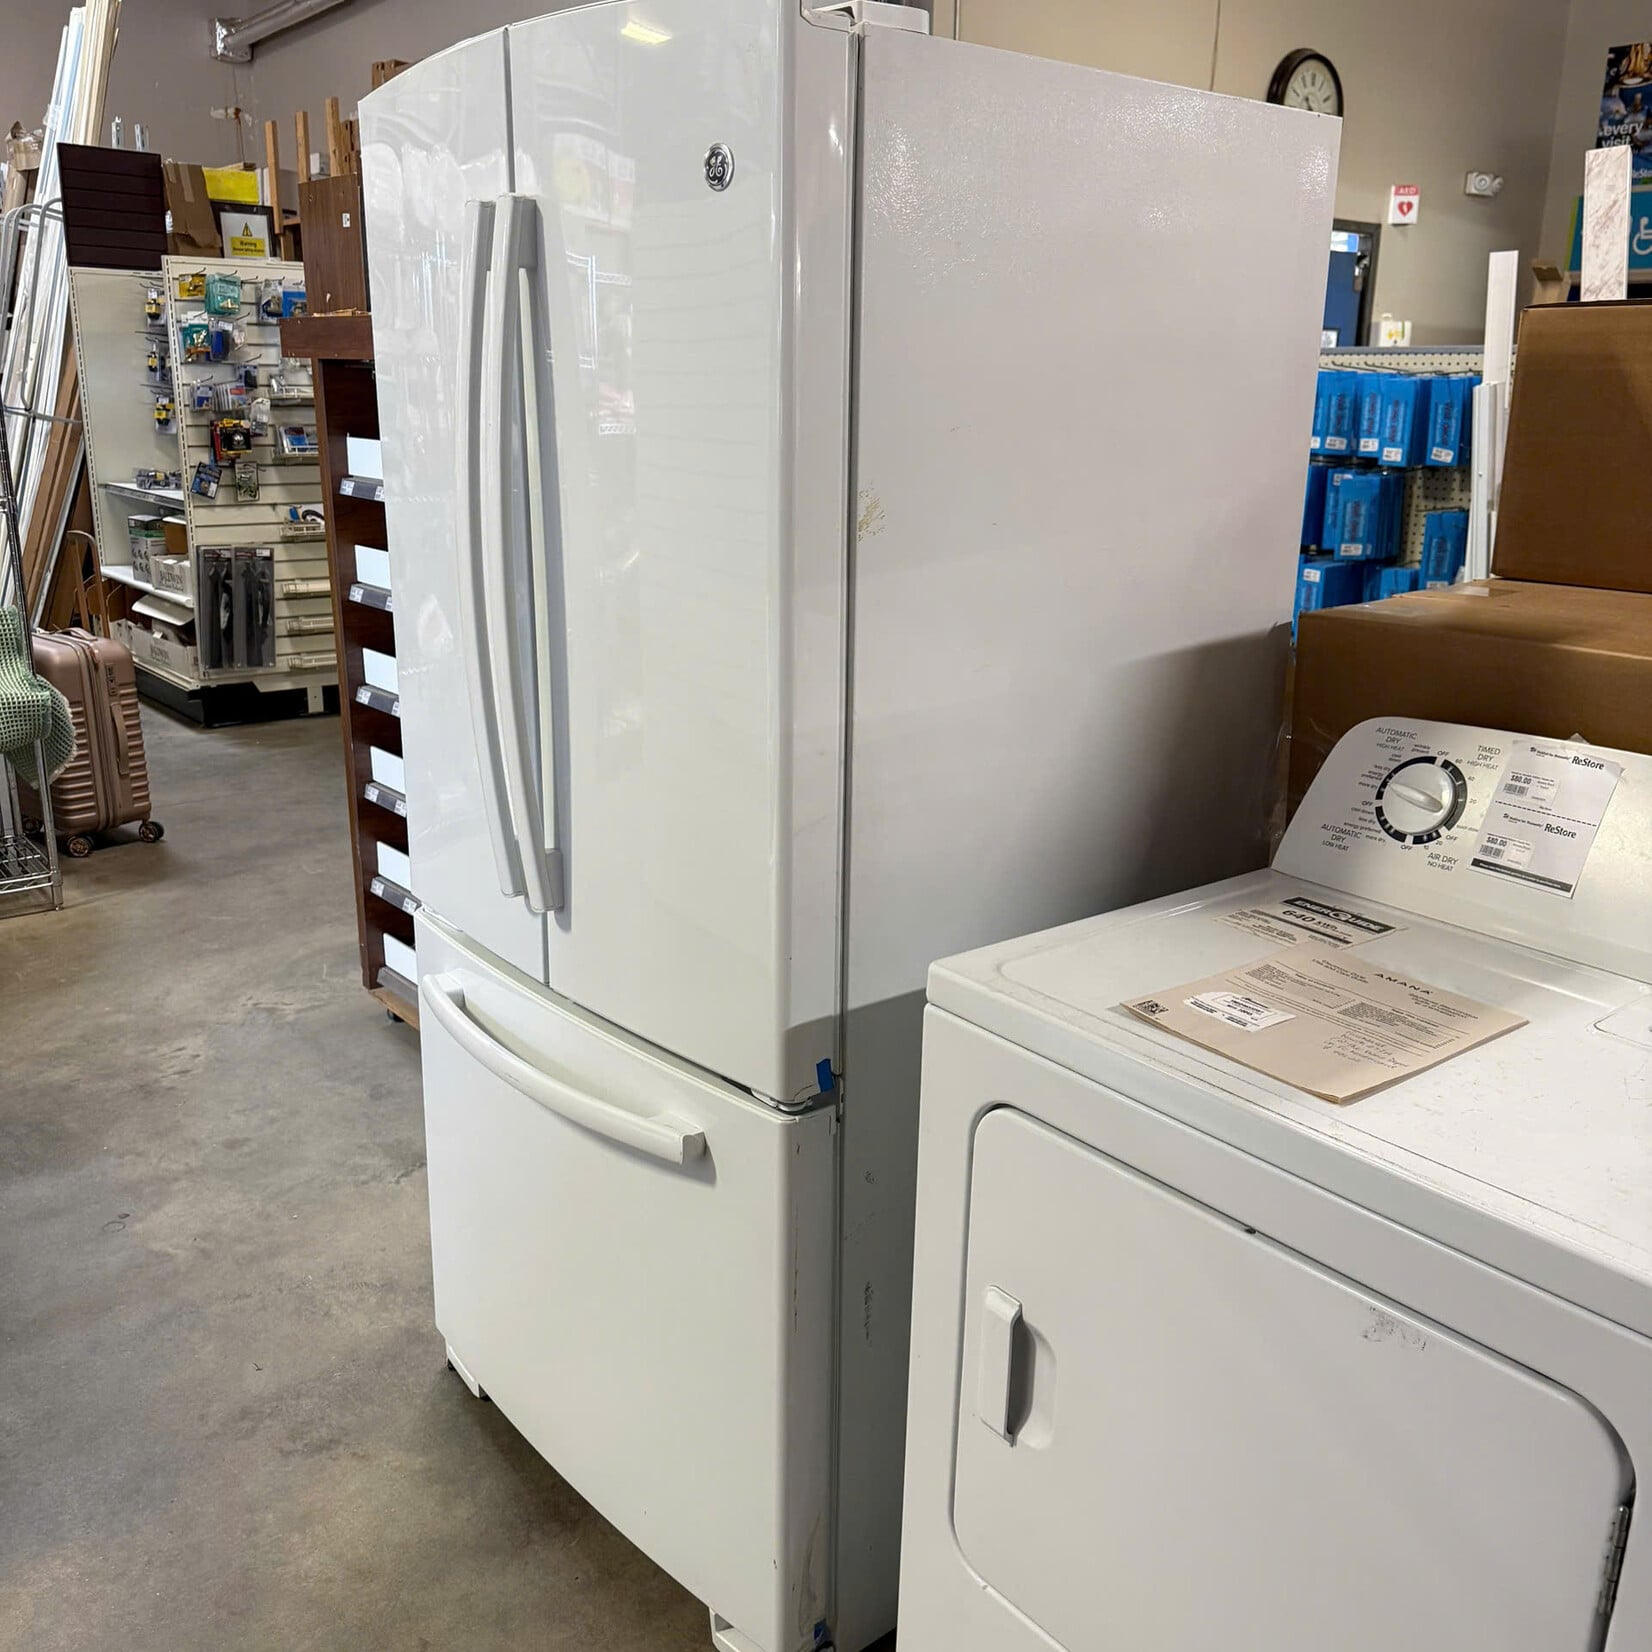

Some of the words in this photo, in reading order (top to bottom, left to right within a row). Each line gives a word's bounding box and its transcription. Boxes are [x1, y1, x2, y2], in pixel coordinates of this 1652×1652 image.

[1376, 728, 1418, 740] AUTOMATIC
[1478, 746, 1501, 755] TIMED
[1477, 754, 1494, 762] DRY
[1572, 756, 1604, 770] ReStore
[1510, 774, 1532, 785] $80.00
[1320, 823, 1362, 839] AUTOMATIC
[1544, 823, 1576, 838] ReStore
[1331, 834, 1346, 843] DRY
[1335, 843, 1349, 851] HEAT
[1428, 852, 1440, 861] AIR
[1442, 855, 1458, 865] DRY
[1438, 863, 1454, 871] HEAT
[1282, 910, 1316, 923] 640
[1374, 973, 1431, 995] AMANA
